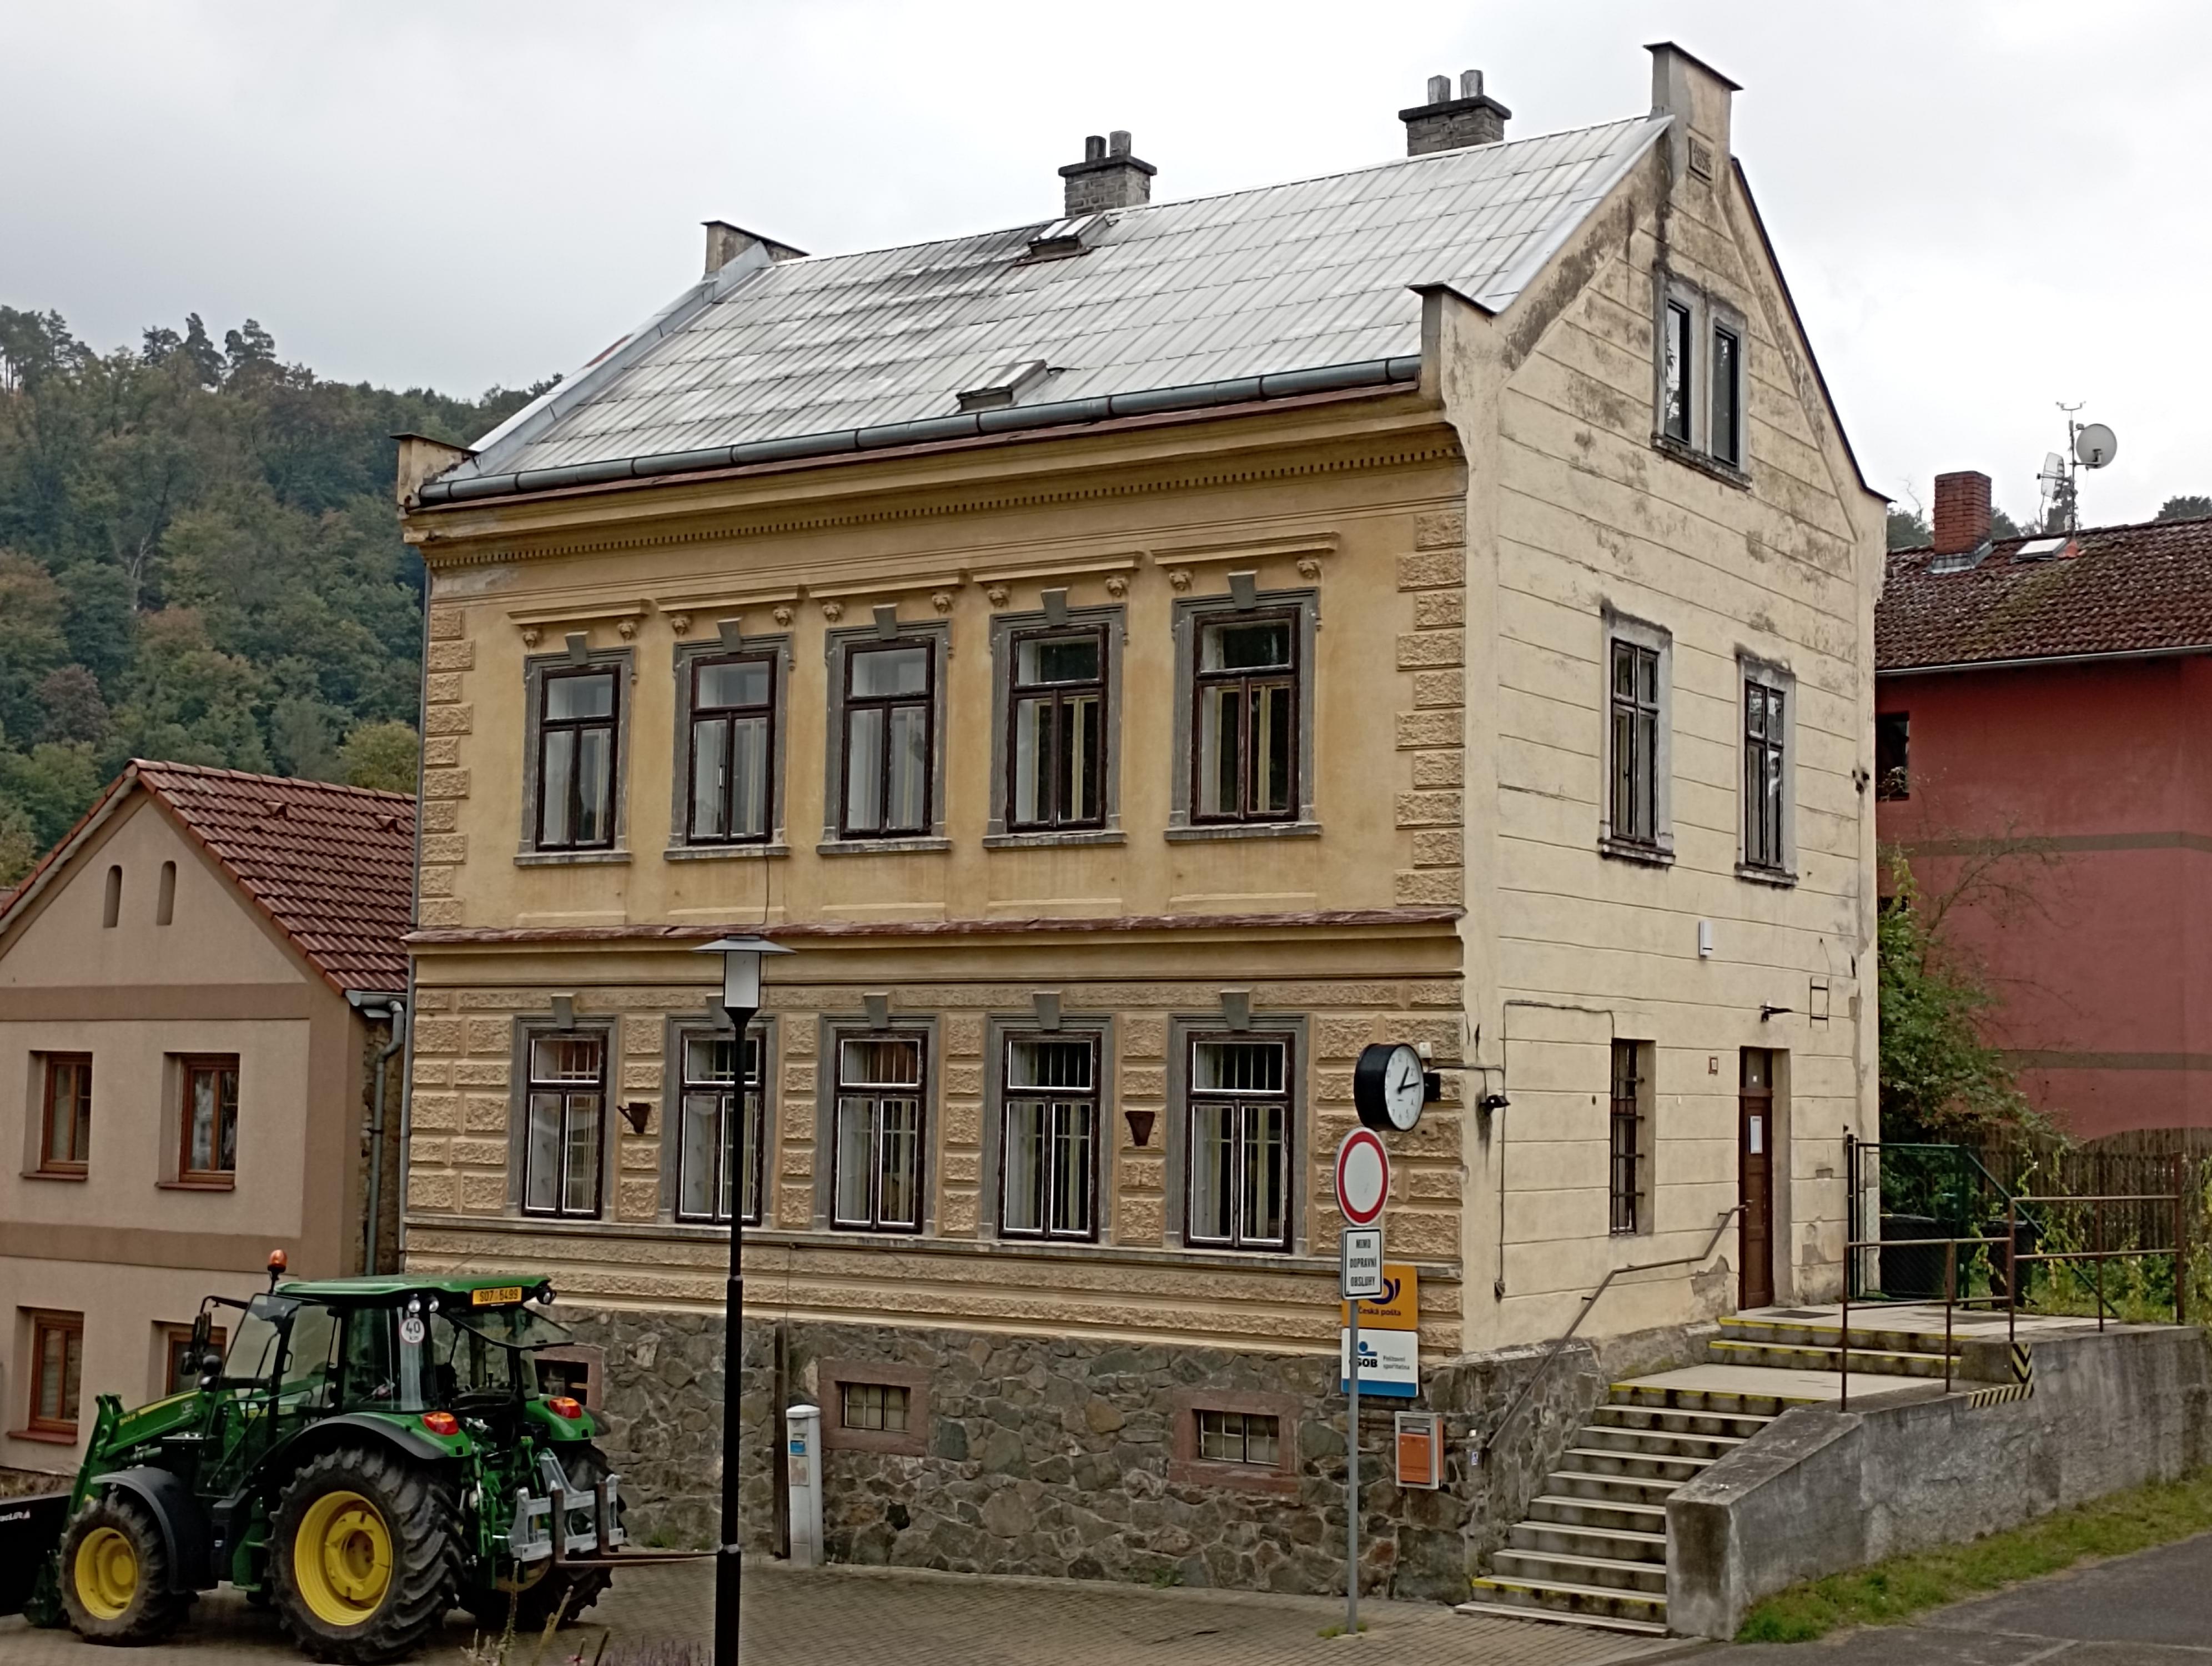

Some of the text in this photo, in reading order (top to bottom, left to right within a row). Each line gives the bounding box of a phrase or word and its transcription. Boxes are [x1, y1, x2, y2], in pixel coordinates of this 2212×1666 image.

[1356, 1239, 1371, 1248] MIMO
[1350, 1256, 1377, 1268] DOPRAVNÍ
[1350, 1276, 1375, 1287] OBSLUHY
[406, 1321, 420, 1334] 40
[1350, 1358, 1378, 1368] SOB
